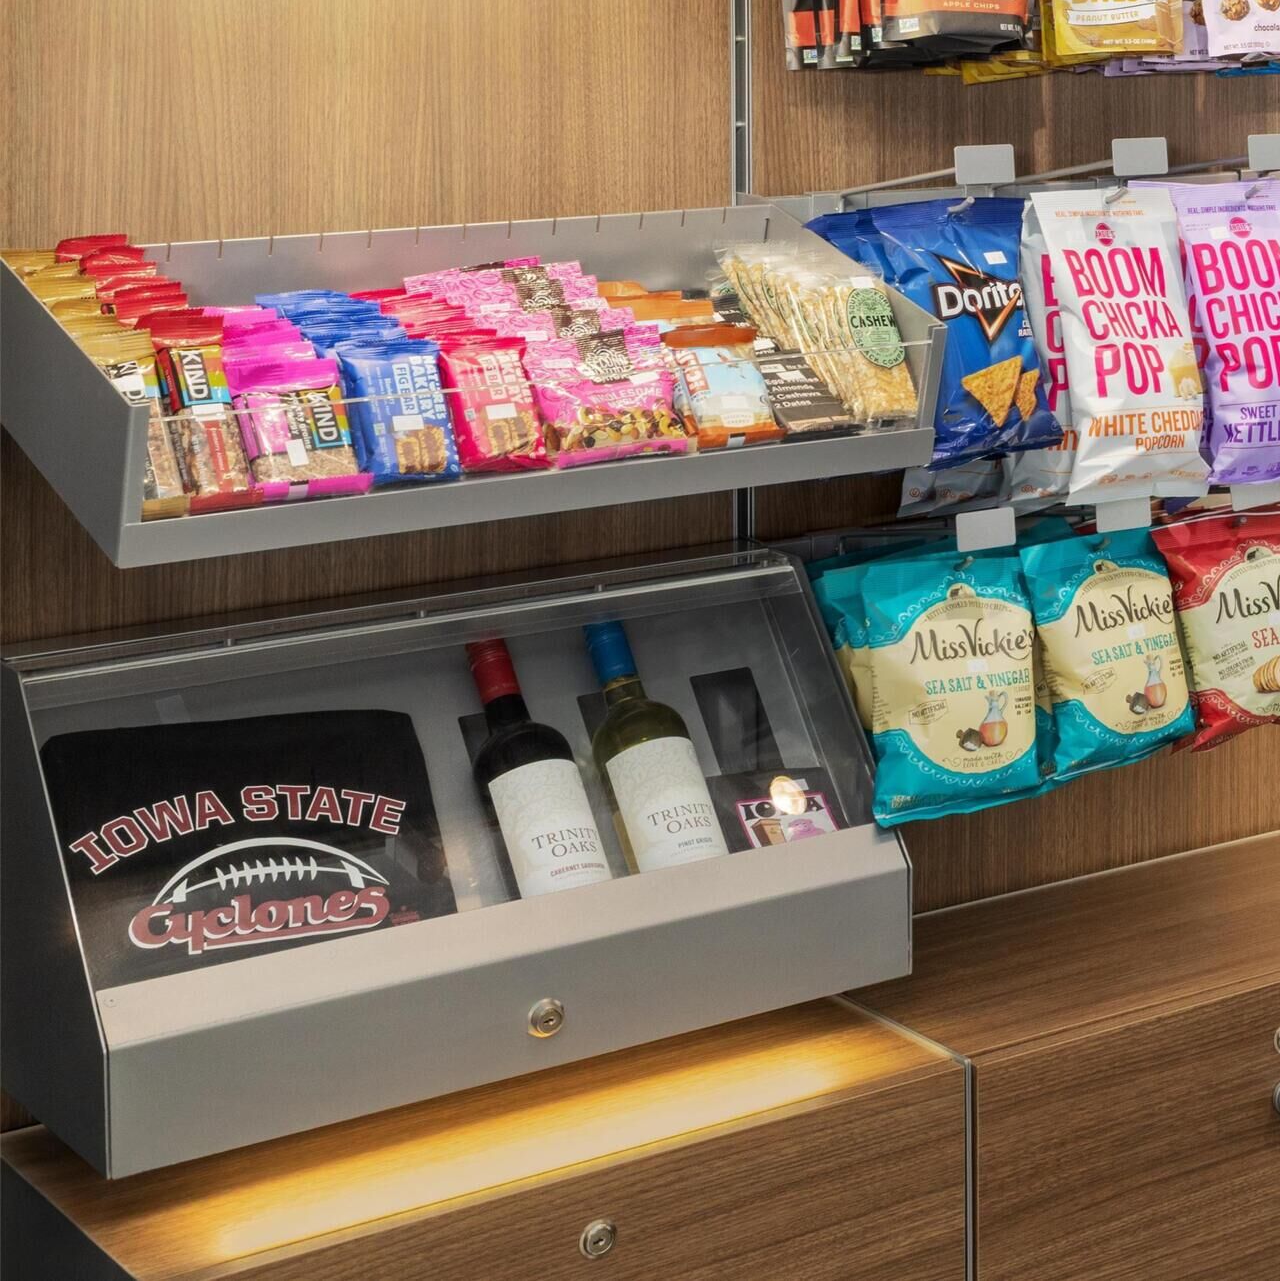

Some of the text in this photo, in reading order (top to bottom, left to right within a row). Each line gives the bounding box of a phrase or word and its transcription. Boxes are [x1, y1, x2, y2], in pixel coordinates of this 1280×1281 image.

[1062, 248, 1166, 297] BOOM
[851, 315, 895, 328] CASHEW
[1081, 302, 1183, 340] CHICKA
[180, 350, 210, 401] KIND
[1094, 342, 1164, 397] POP
[1240, 405, 1276, 420] SWEET
[1136, 437, 1184, 451] POPCORN
[1252, 629, 1280, 648] SEA
[926, 672, 1030, 694] SEA SALT & VINEGAR
[70, 785, 406, 873] IOWA STATE
[532, 827, 597, 851] TRINITY
[551, 840, 598, 858] OAKS
[130, 887, 390, 954] Cyclones
